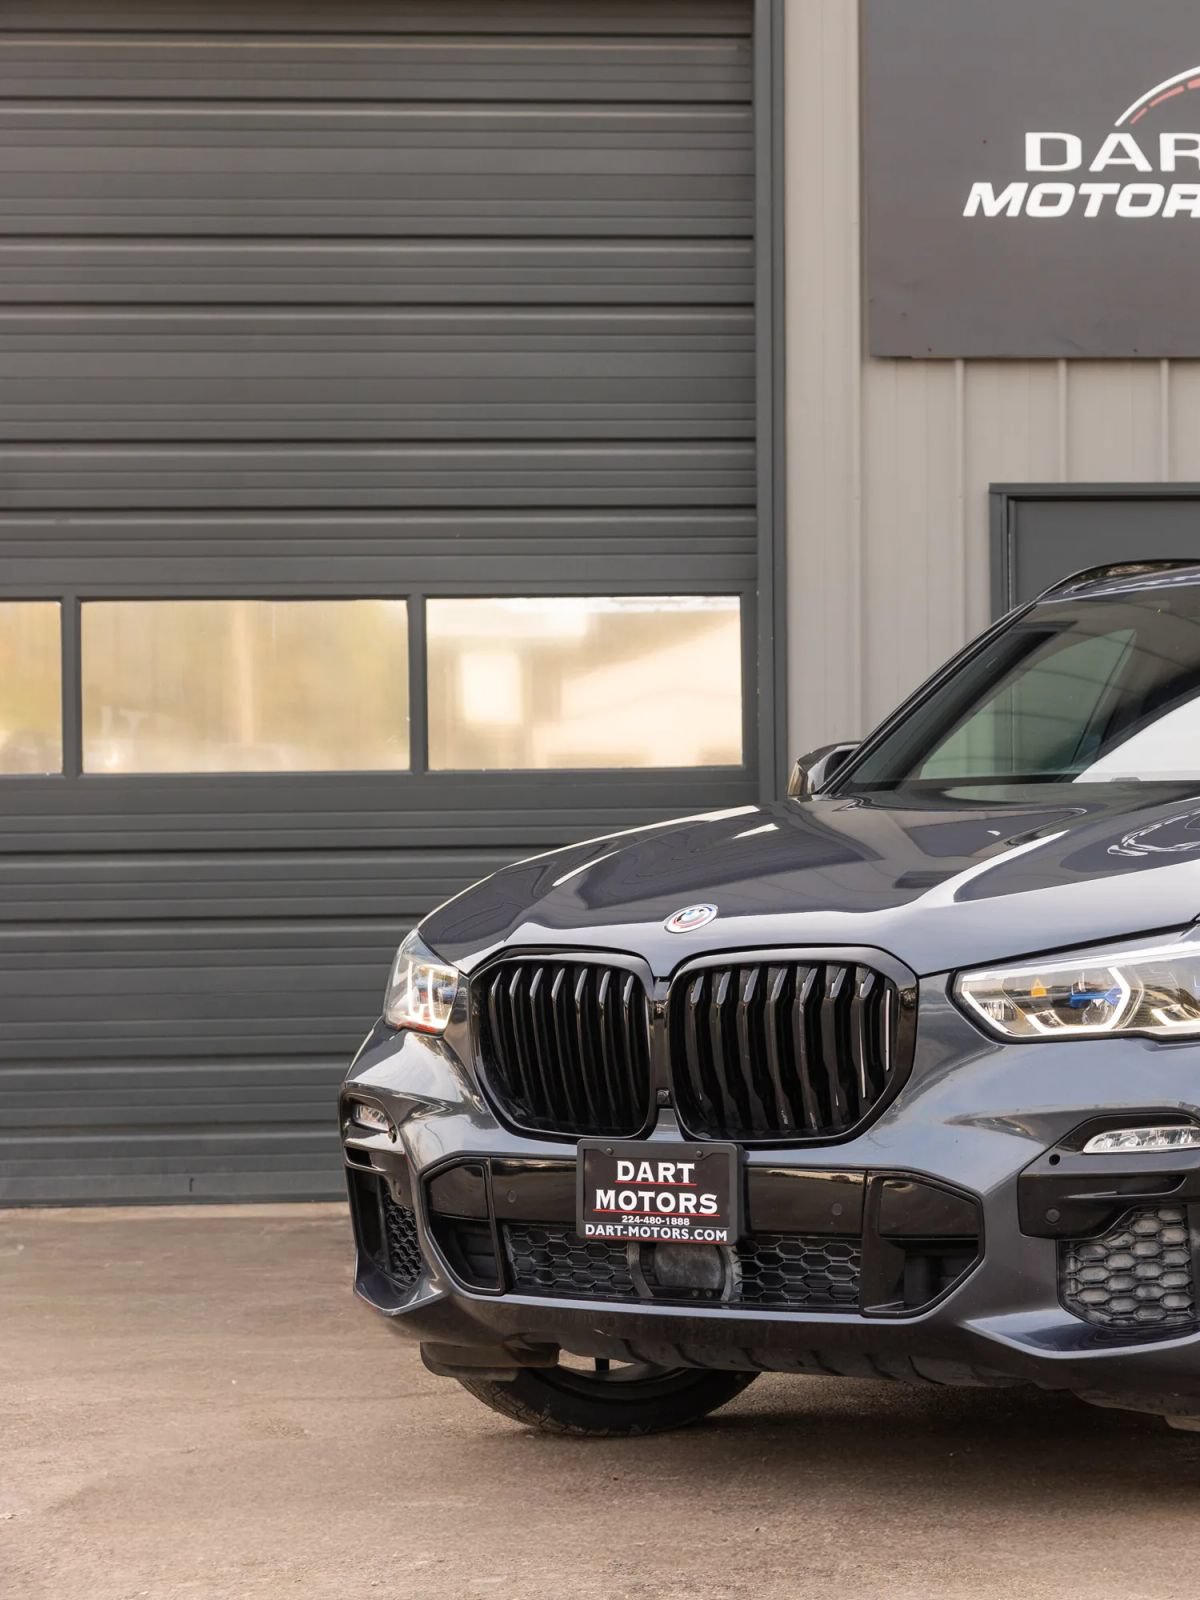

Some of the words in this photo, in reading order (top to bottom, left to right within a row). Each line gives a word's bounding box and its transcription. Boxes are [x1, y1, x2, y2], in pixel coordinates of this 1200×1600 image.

[616, 1160, 695, 1184] DART
[596, 1189, 718, 1214] MOTORS
[621, 1215, 691, 1226] 224-480-1888
[585, 1224, 728, 1242] DART-MOTORS.COM
